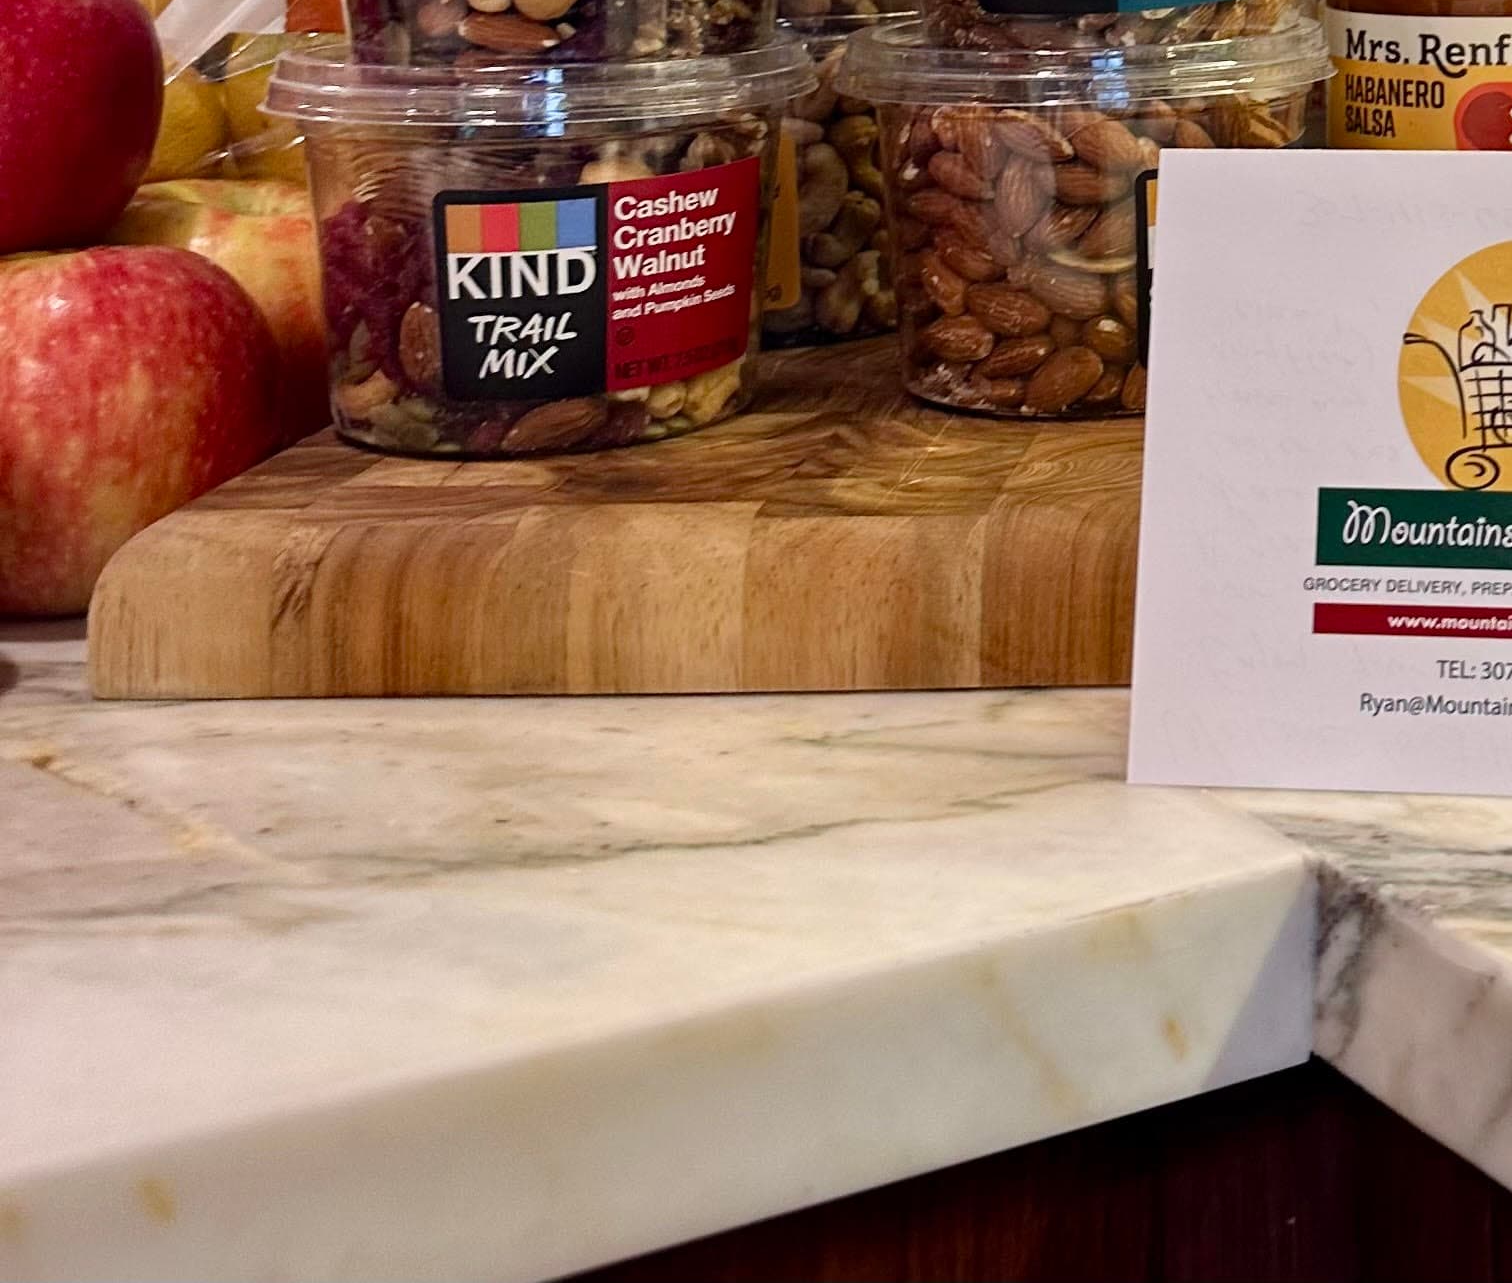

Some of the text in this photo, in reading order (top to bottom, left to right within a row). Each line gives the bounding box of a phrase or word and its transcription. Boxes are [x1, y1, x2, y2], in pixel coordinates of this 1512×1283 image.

[1345, 29, 1409, 64] Mrs.
[1345, 73, 1445, 109] HABANERO
[1345, 108, 1396, 138] SALSA
[614, 187, 719, 221] Cashew
[613, 211, 737, 251] Cranberry
[448, 248, 598, 301] KIND
[612, 244, 706, 280] Walnut
[612, 274, 706, 301] with Almonds
[612, 302, 643, 320] and
[644, 293, 703, 315] Pumpkin
[467, 312, 578, 345] TRAIL
[479, 346, 559, 380] MIX
[1302, 576, 1381, 594] GROCERY
[1385, 577, 1467, 598] DELIVERY,
[1436, 659, 1476, 680] TEL:
